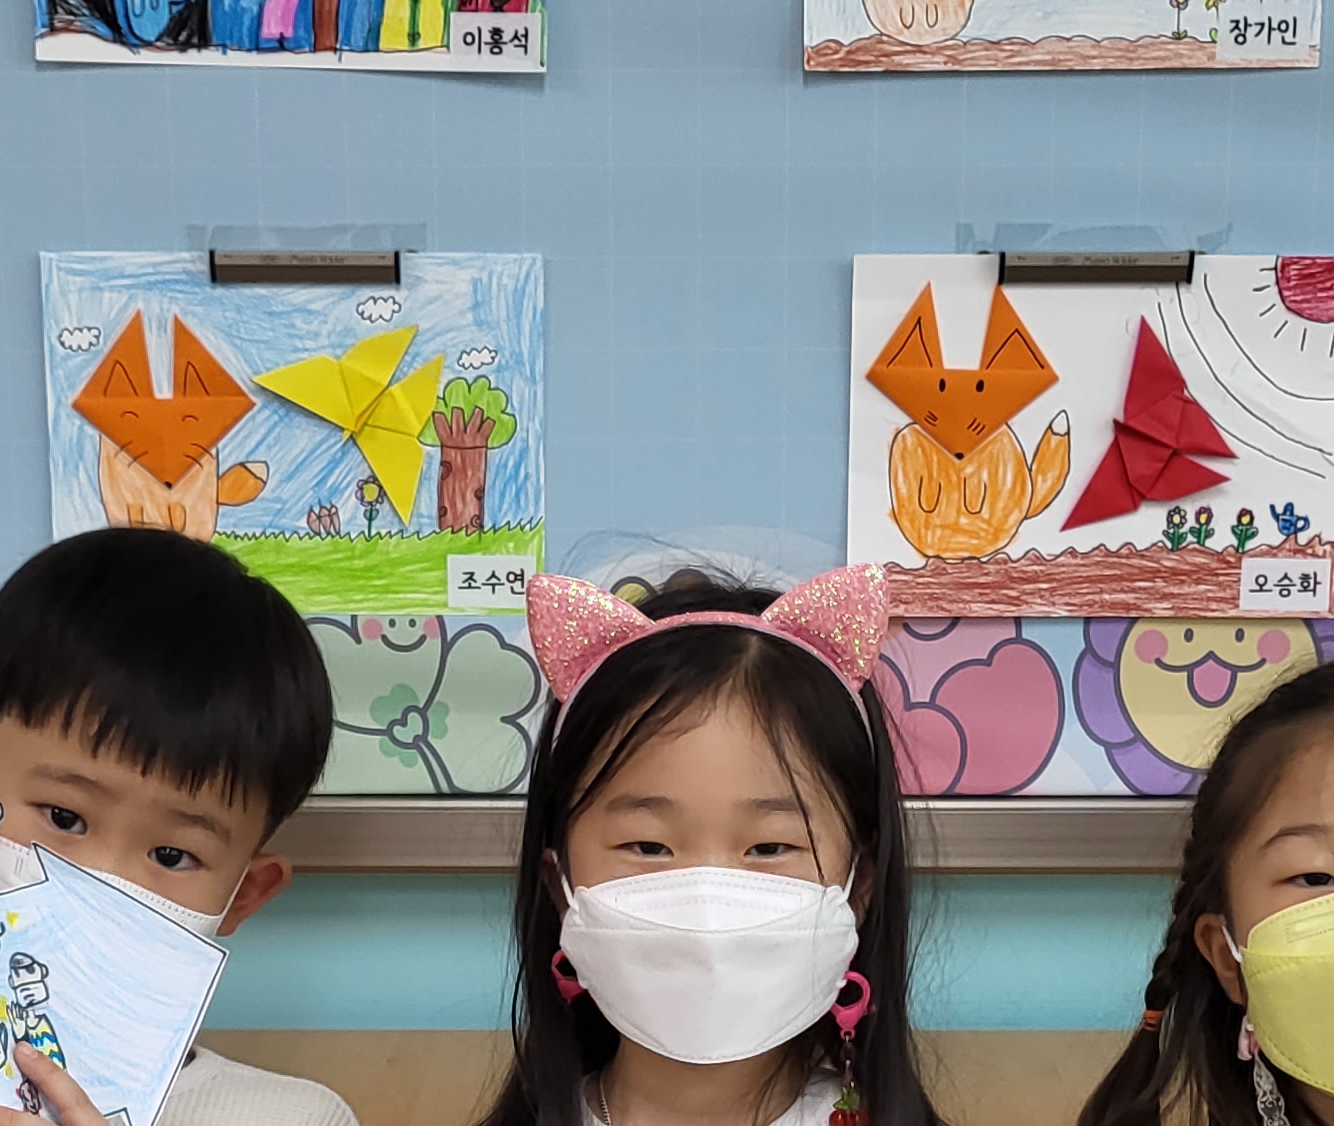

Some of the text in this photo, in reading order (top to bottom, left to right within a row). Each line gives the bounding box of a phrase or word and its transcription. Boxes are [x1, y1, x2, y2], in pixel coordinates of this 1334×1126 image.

[462, 25, 529, 56] 이홍석
[1229, 15, 1298, 46] 장가인
[457, 568, 526, 596] 조수연
[1248, 571, 1322, 599] 오승화
